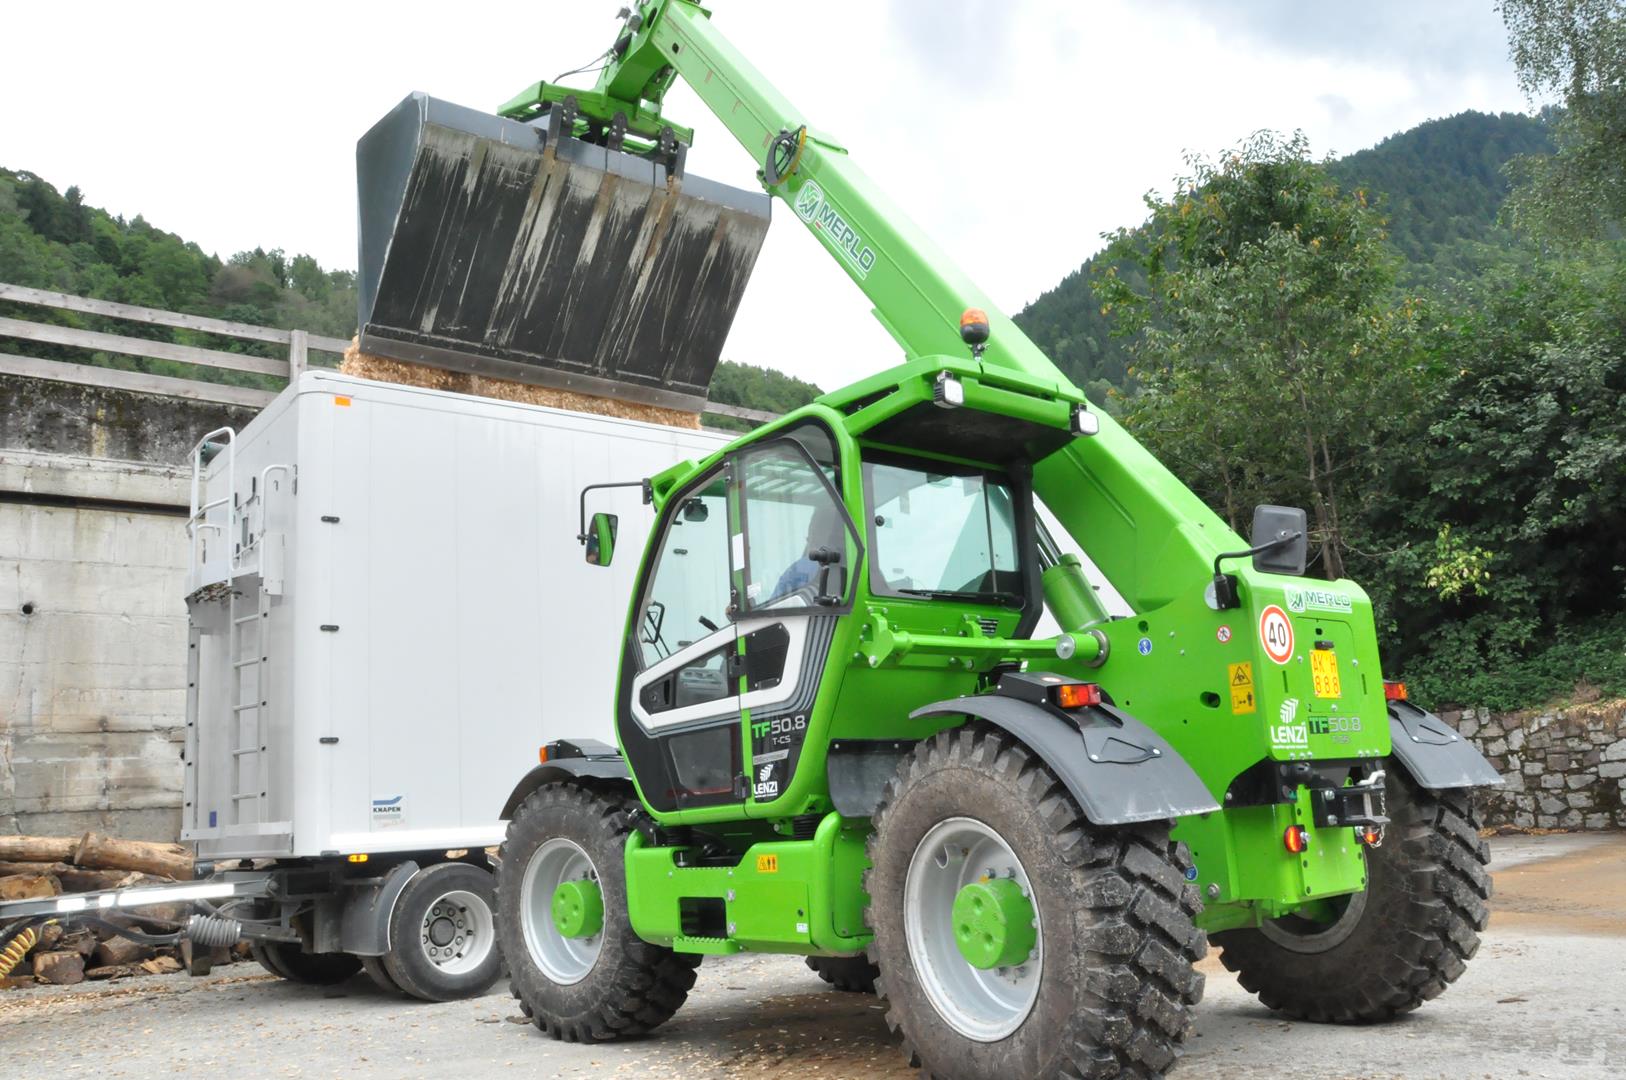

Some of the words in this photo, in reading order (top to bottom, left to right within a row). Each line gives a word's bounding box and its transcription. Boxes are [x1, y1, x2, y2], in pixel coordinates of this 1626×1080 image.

[818, 202, 875, 271] MERLO
[1305, 590, 1350, 606] MERLO
[1268, 621, 1287, 647] 40
[1270, 721, 1308, 744] LENZI
[753, 781, 778, 795] LENZI
